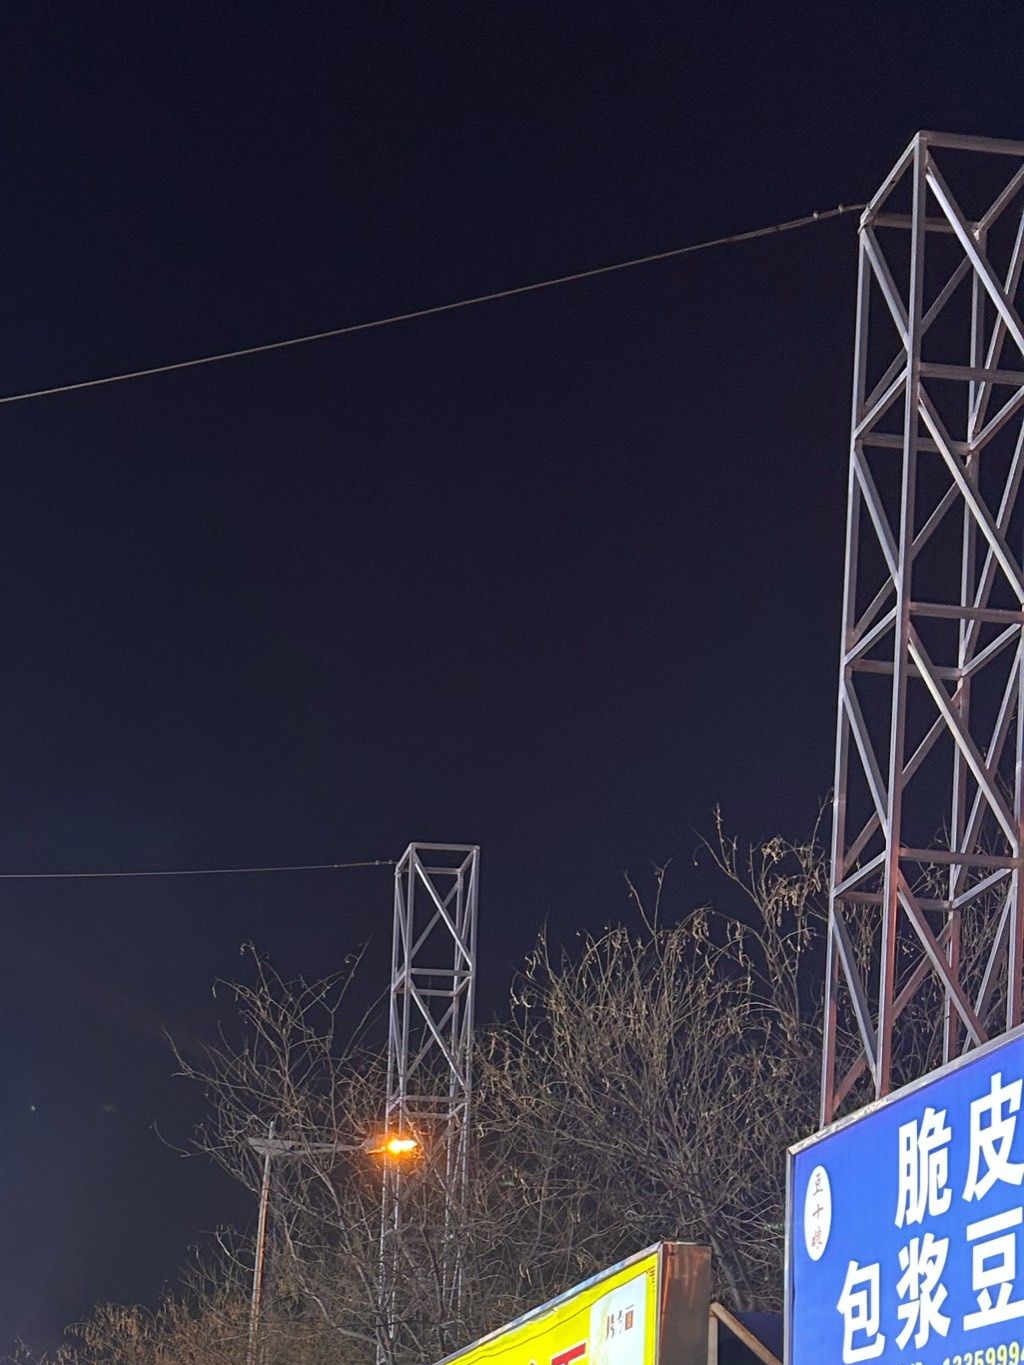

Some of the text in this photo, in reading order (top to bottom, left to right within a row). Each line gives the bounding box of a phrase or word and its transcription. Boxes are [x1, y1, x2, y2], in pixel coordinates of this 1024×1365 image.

[894, 1070, 1024, 1230] 脆皮
[836, 1207, 1024, 1365] 包浆豆
